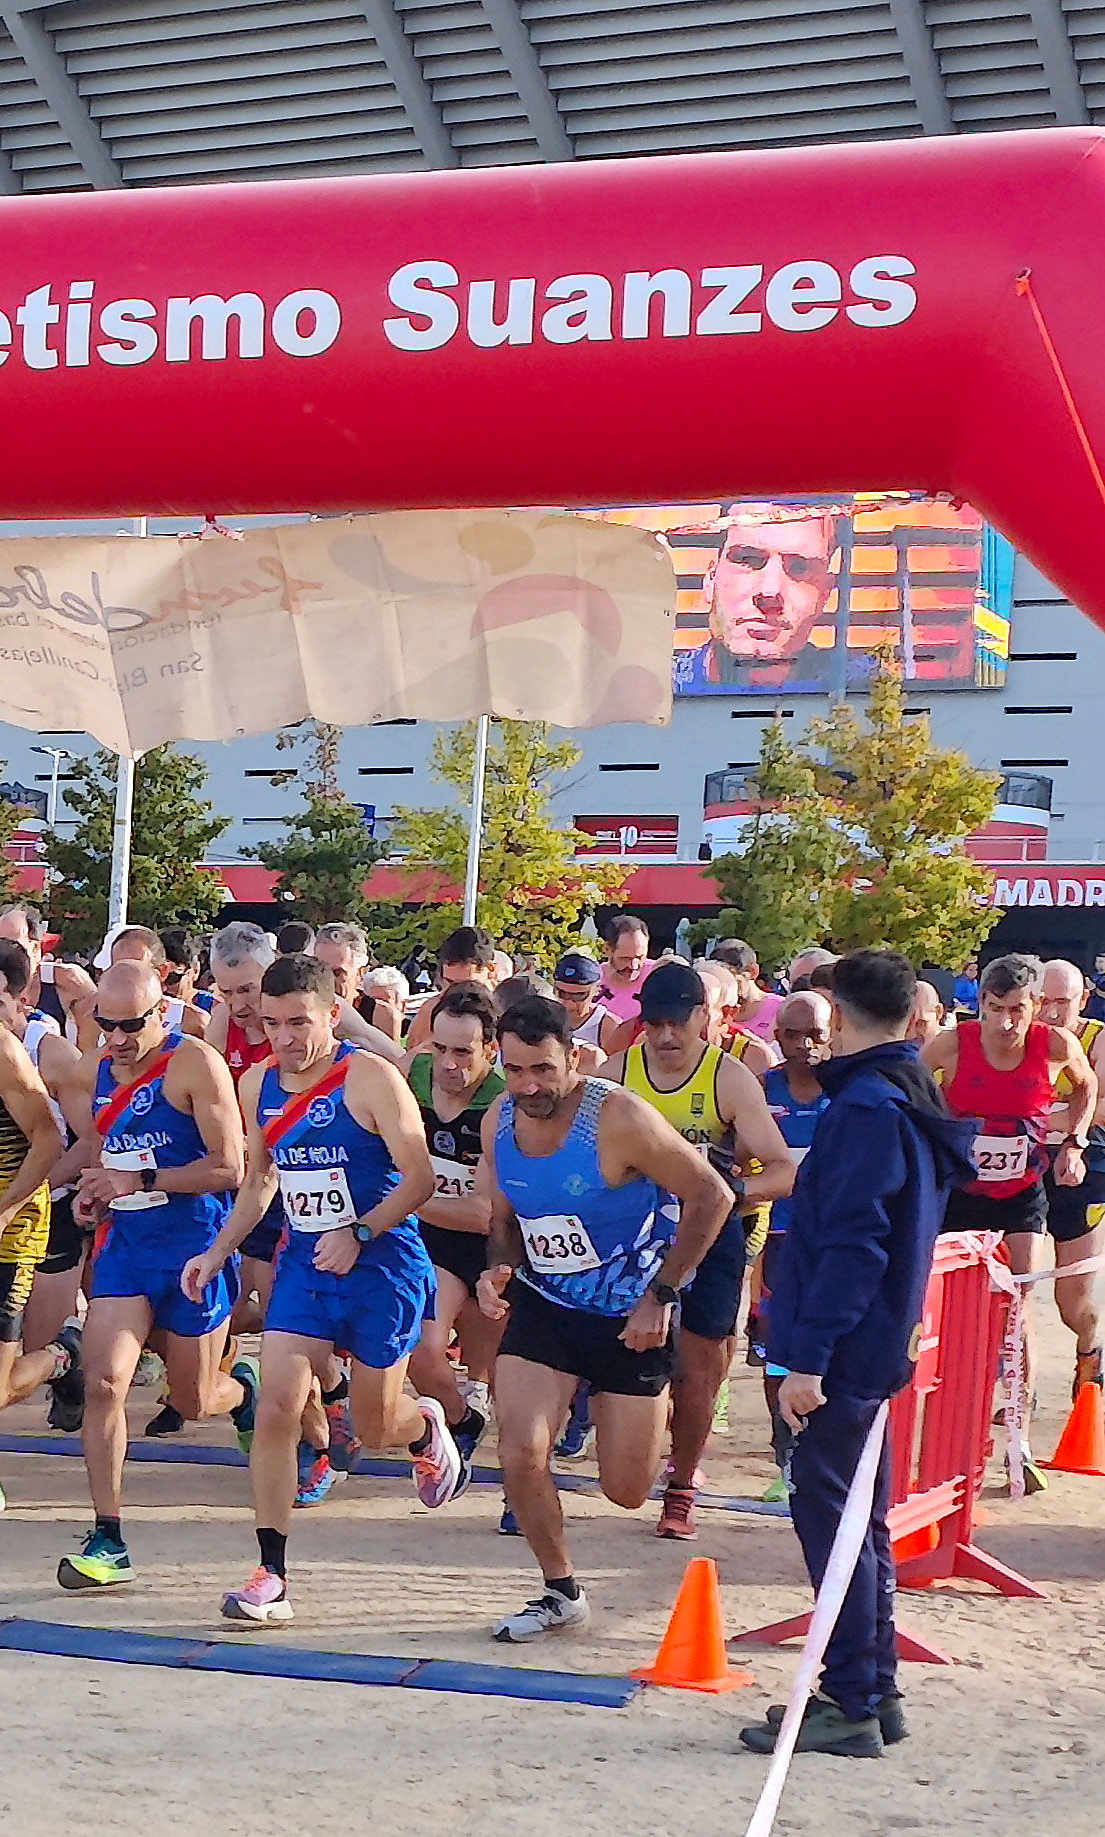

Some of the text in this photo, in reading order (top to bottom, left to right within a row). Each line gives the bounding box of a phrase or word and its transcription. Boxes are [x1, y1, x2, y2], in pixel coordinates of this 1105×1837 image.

[383, 254, 917, 351] Suanzes
[619, 826, 638, 847] 10
[287, 1189, 345, 1217] 1279
[527, 1233, 587, 1258] 1238
